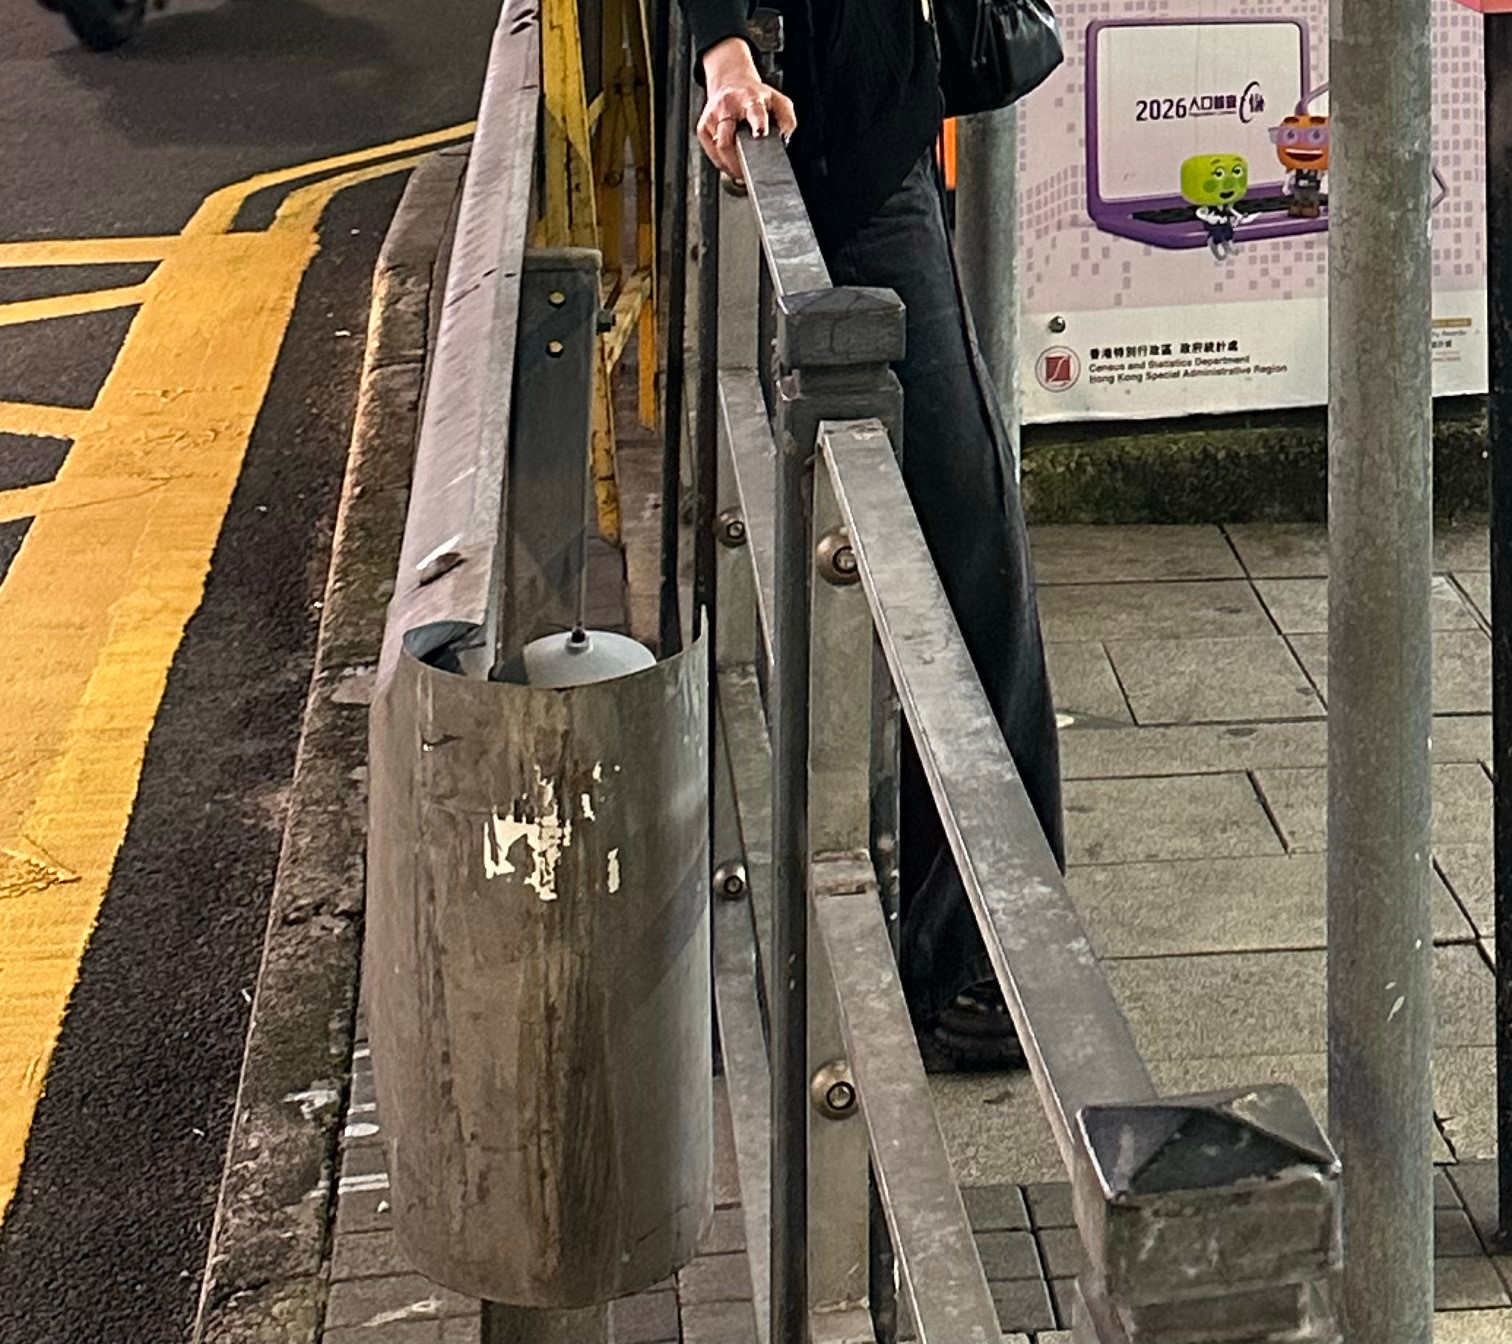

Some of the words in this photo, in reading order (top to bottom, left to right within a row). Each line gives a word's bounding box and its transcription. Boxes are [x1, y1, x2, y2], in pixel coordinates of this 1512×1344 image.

[1136, 98, 1187, 121] 2026
[1128, 360, 1146, 370] and
[1195, 355, 1250, 367] Department
[1089, 374, 1115, 385] Hong
[1118, 373, 1143, 384] Kong
[1146, 370, 1180, 381] Special
[1183, 367, 1251, 378] Administrative
[1253, 364, 1288, 375] Region
